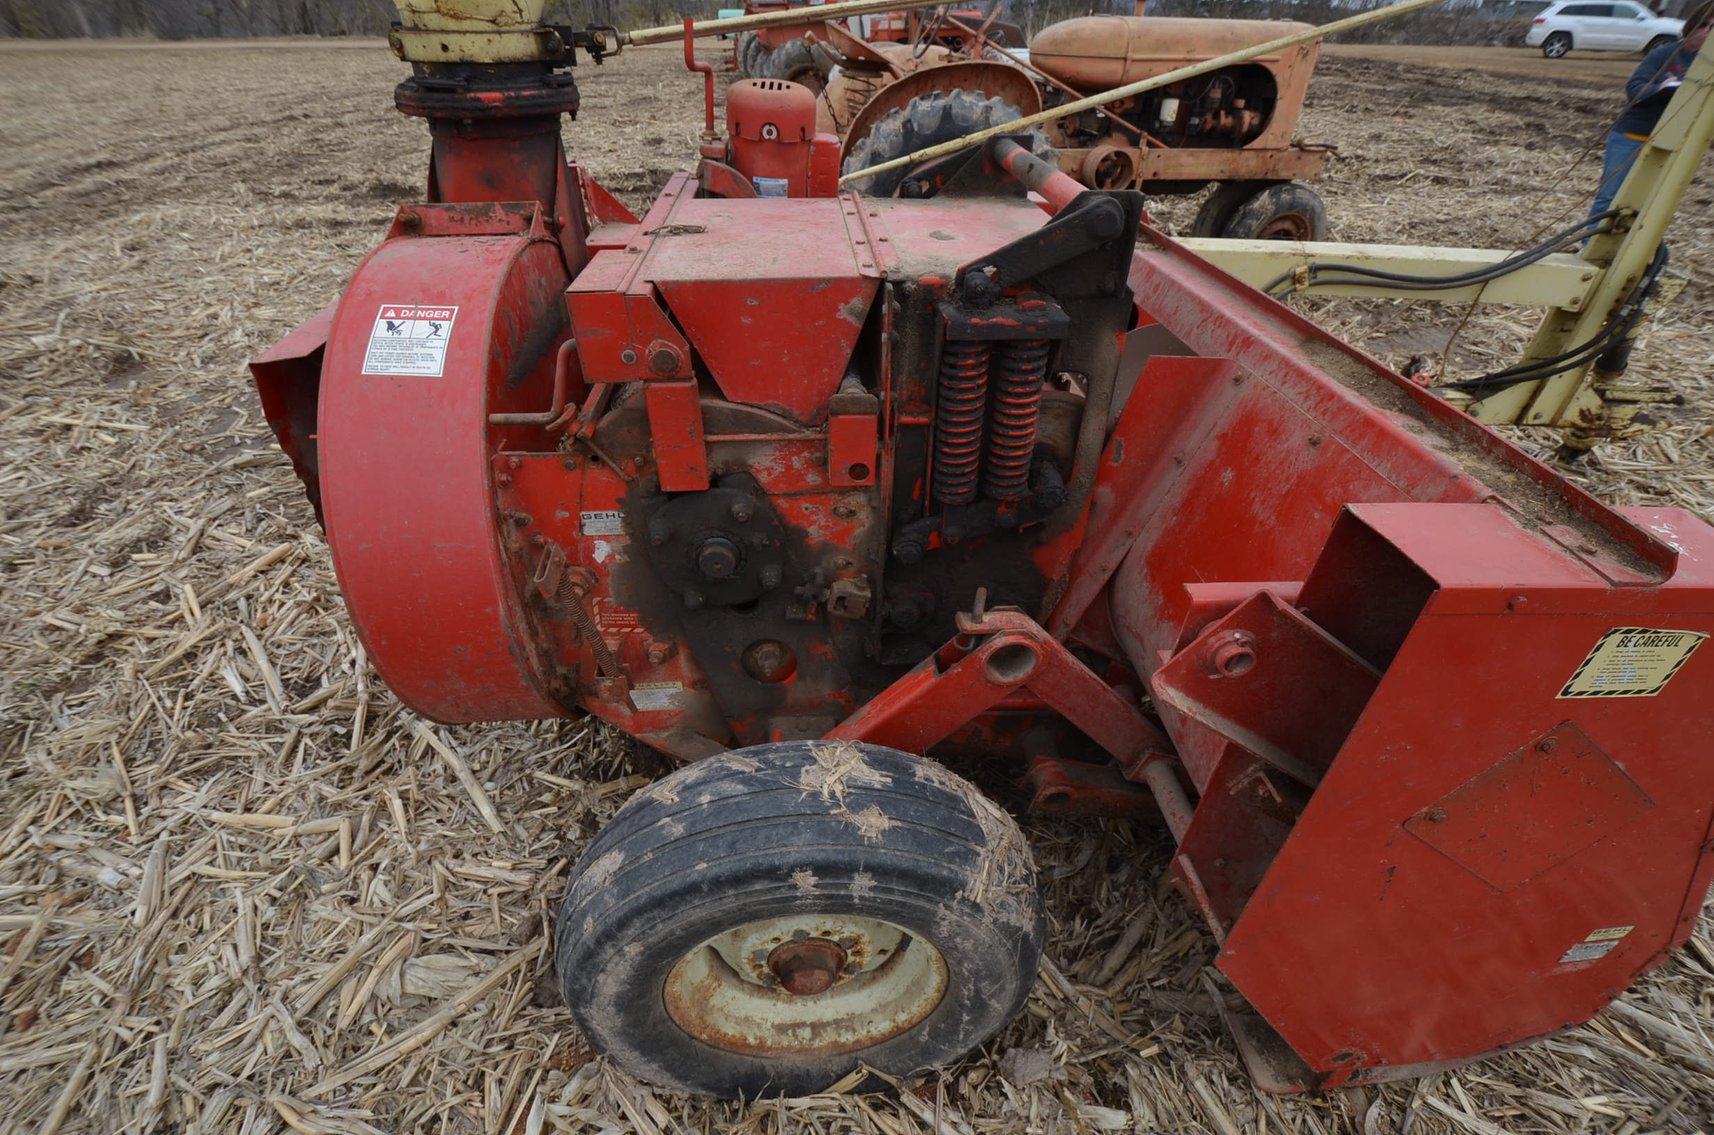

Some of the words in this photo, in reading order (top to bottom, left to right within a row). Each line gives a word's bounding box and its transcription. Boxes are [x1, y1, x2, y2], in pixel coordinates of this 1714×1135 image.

[400, 309, 450, 319] DANGER
[1616, 635, 1633, 648] BE
[1633, 634, 1685, 648] CAREFUL
